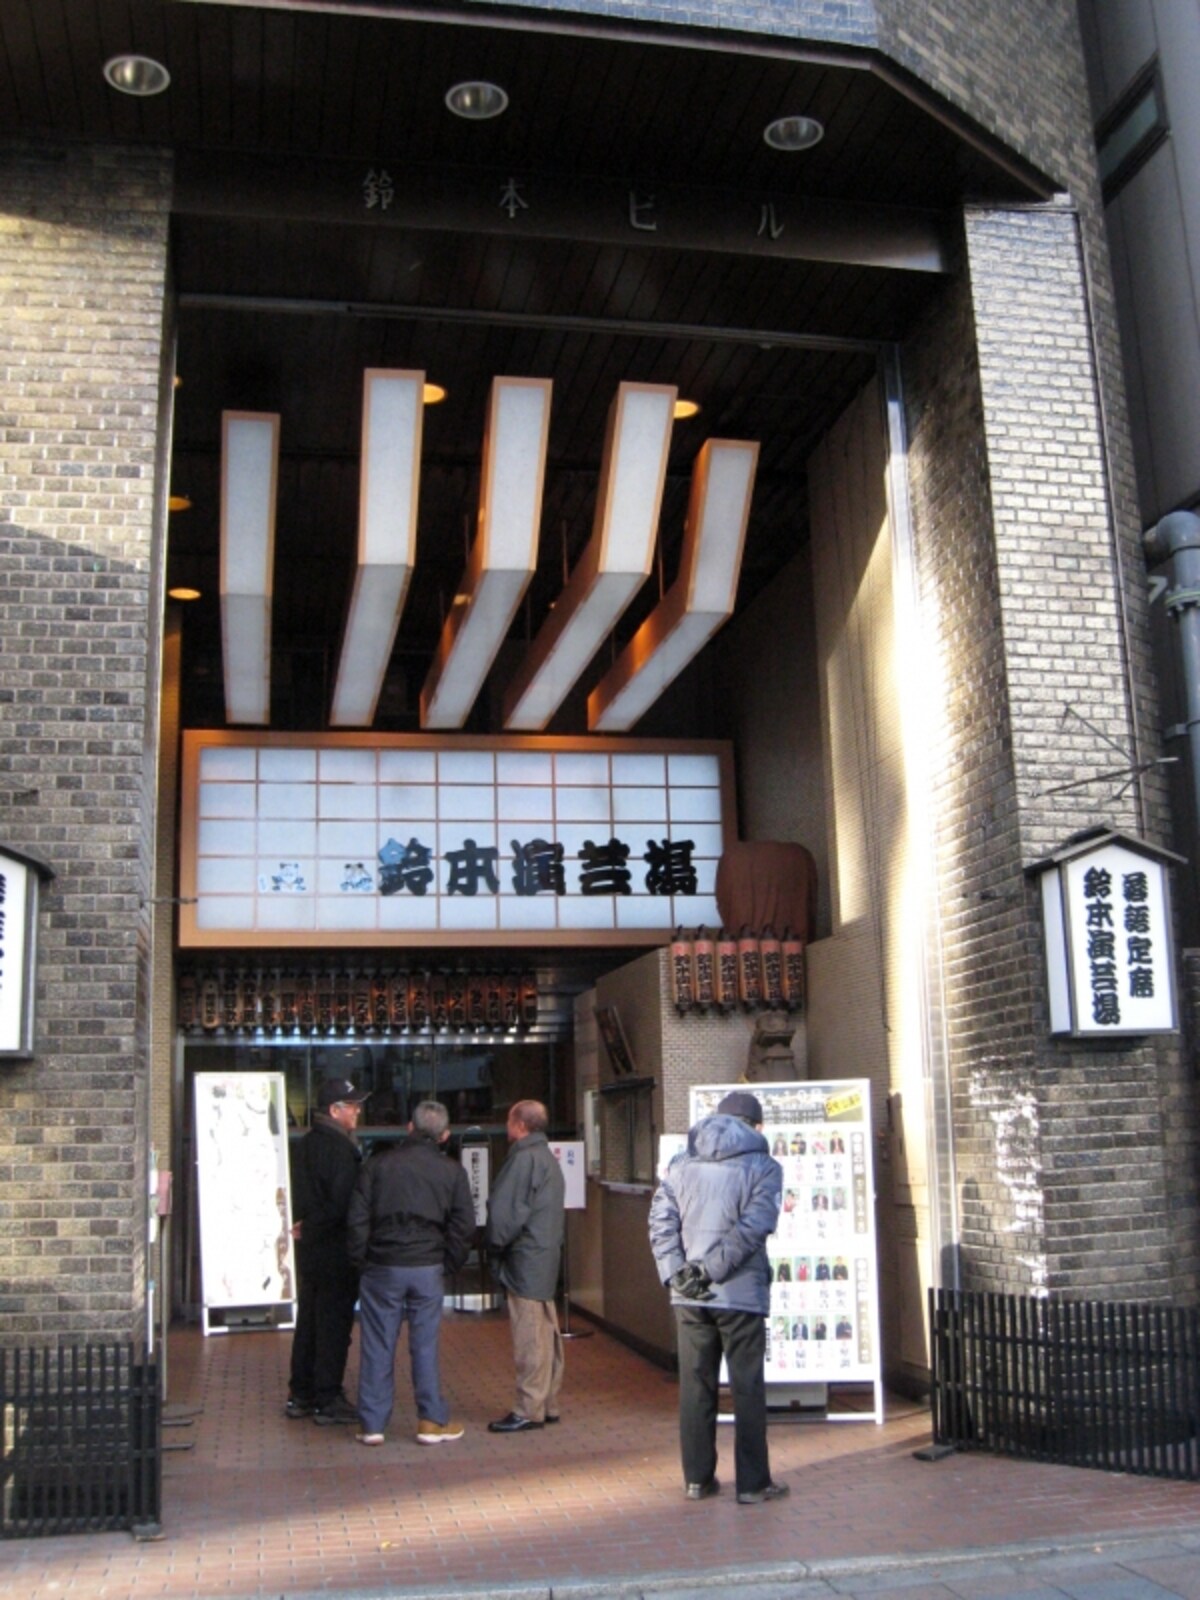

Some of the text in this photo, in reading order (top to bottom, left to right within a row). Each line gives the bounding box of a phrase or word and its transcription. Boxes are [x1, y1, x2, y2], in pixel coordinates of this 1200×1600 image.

[362, 167, 786, 241] 鈴本ビル
[377, 836, 699, 897] 鈴本演芸場
